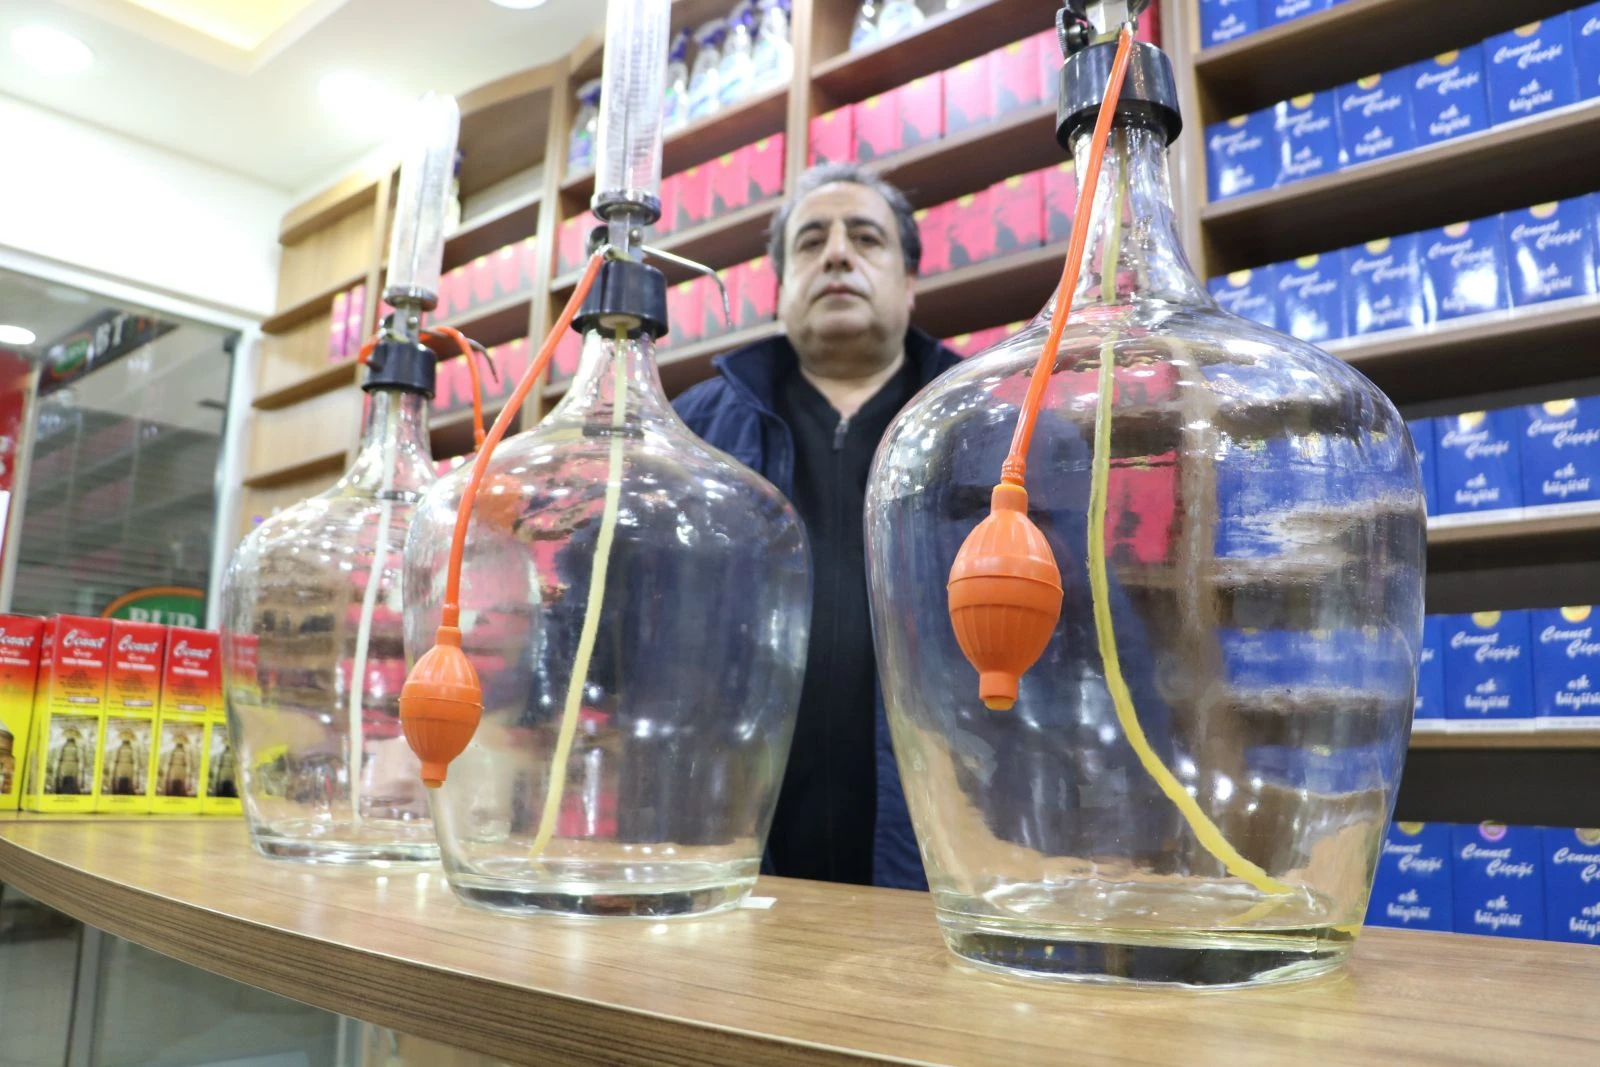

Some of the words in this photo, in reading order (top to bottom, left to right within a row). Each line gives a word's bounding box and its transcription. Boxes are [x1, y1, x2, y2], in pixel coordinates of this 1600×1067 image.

[1451, 631, 1500, 649] Cennet
[1540, 625, 1593, 643] Cennet
[1461, 843, 1512, 859] Cennet
[1486, 859, 1534, 878] Çiçeği
